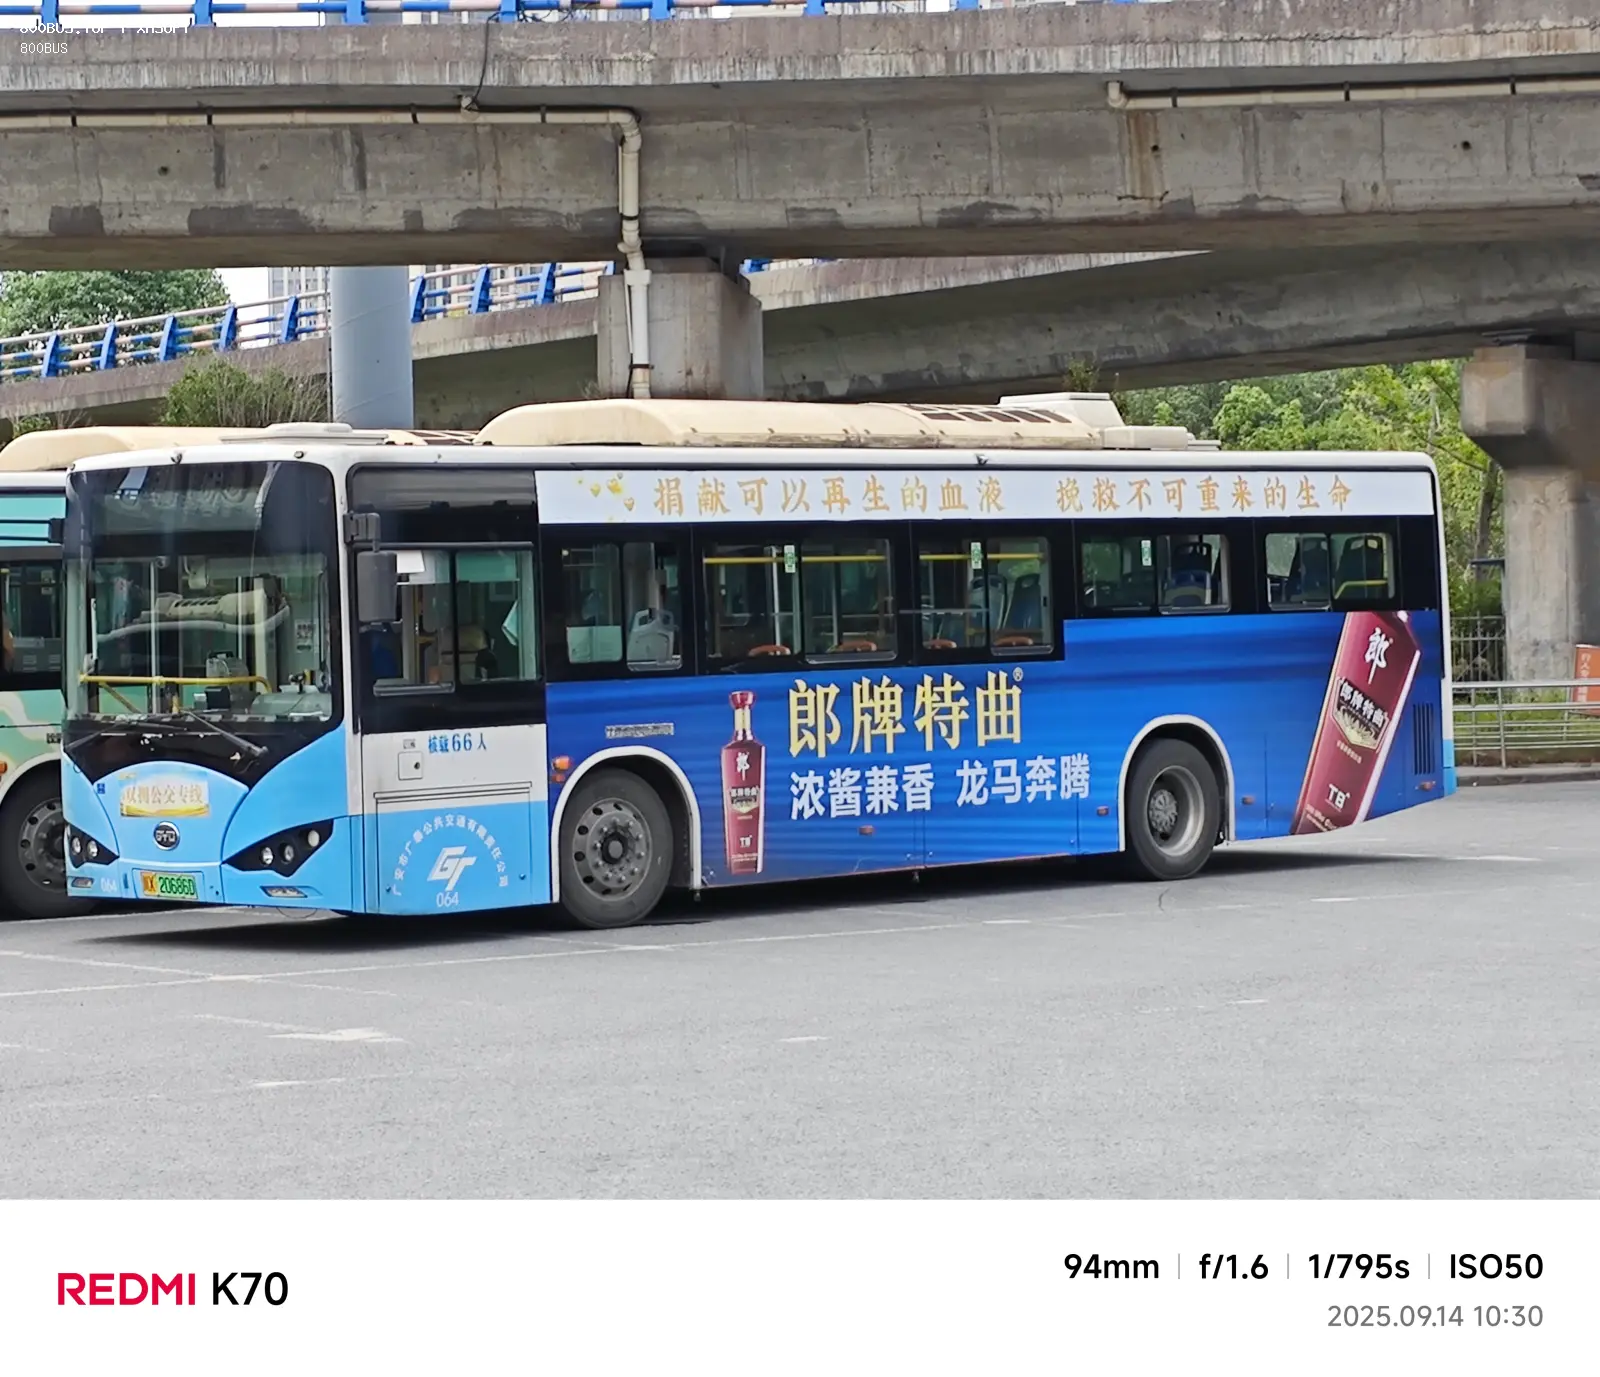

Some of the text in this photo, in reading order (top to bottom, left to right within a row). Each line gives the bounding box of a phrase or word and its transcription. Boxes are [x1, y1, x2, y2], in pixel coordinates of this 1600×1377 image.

[653, 474, 1352, 517] 捐献可以再生的血液 挽救不可重来的生命
[789, 671, 1022, 758] 郎牌特曲
[790, 752, 1091, 821] 浓酱兼香 龙马奔腾
[142, 873, 195, 896] X20686D
[436, 891, 459, 908] 064
